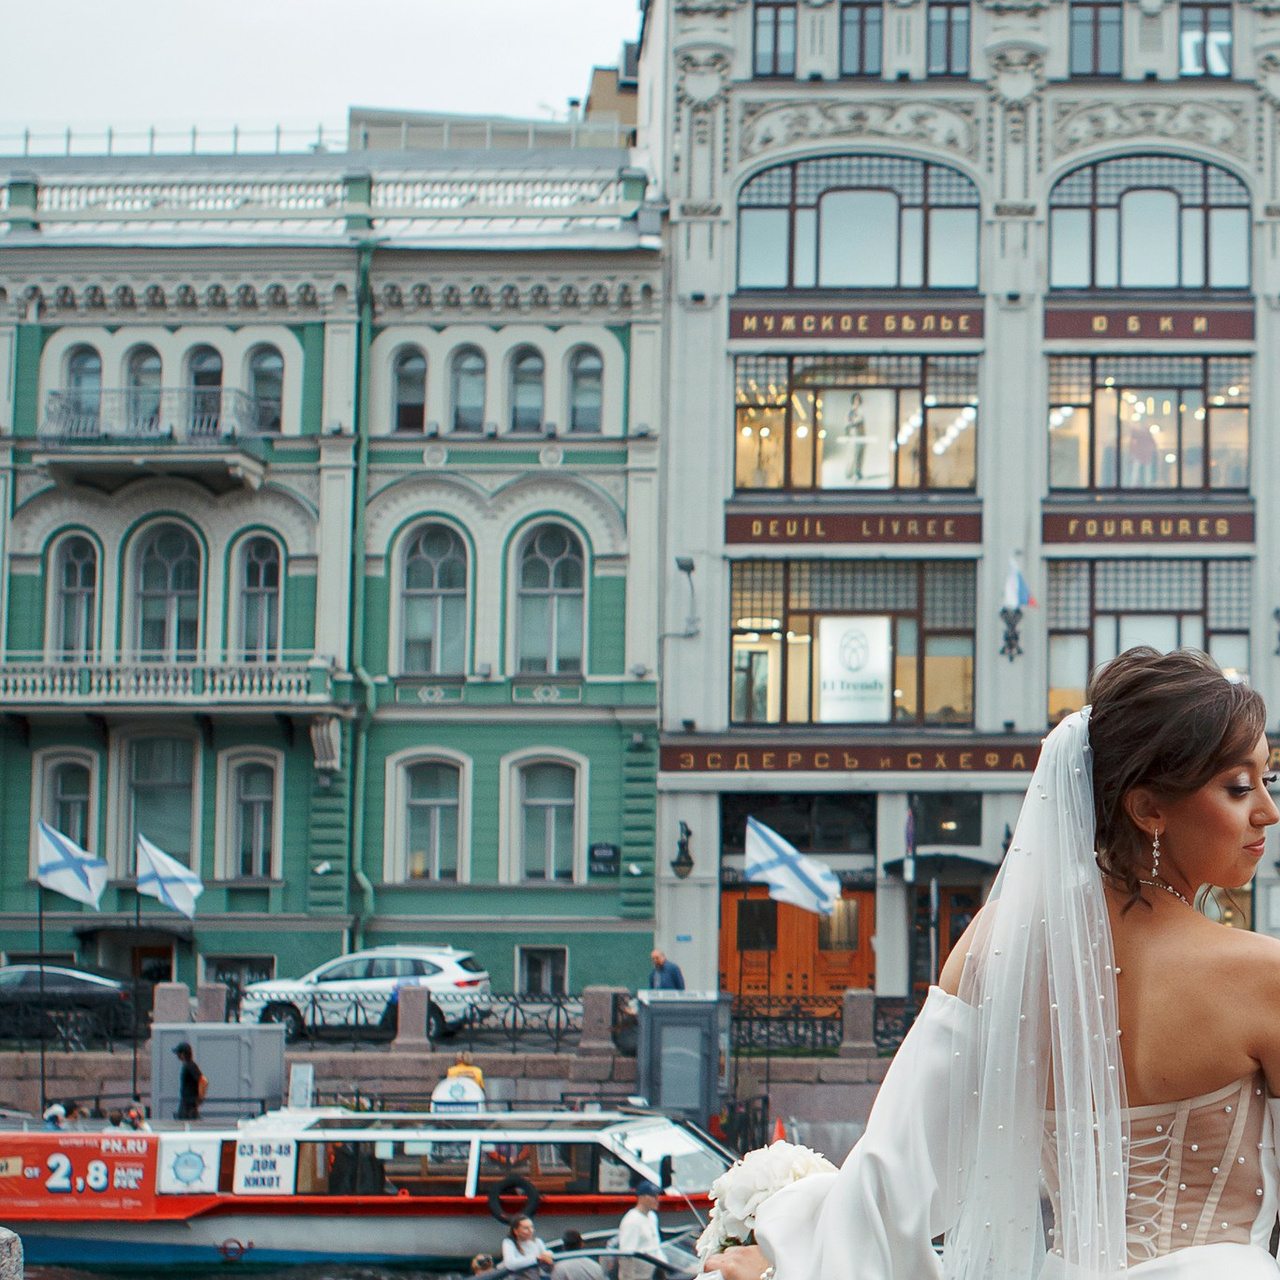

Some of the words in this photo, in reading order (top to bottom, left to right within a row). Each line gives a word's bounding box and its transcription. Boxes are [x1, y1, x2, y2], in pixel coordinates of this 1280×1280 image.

[743, 315, 869, 332] МУЖСКОЕ
[1091, 315, 1208, 332] ЮБКИ
[1068, 519, 1229, 536] FOURRURES
[679, 752, 859, 770] ЭСДЕРСЪ
[101, 1138, 147, 1153] PN.RU
[45, 1152, 109, 1193] 2,8
[250, 1159, 277, 1172] ДОН
[243, 1176, 281, 1188] КИХОТ
